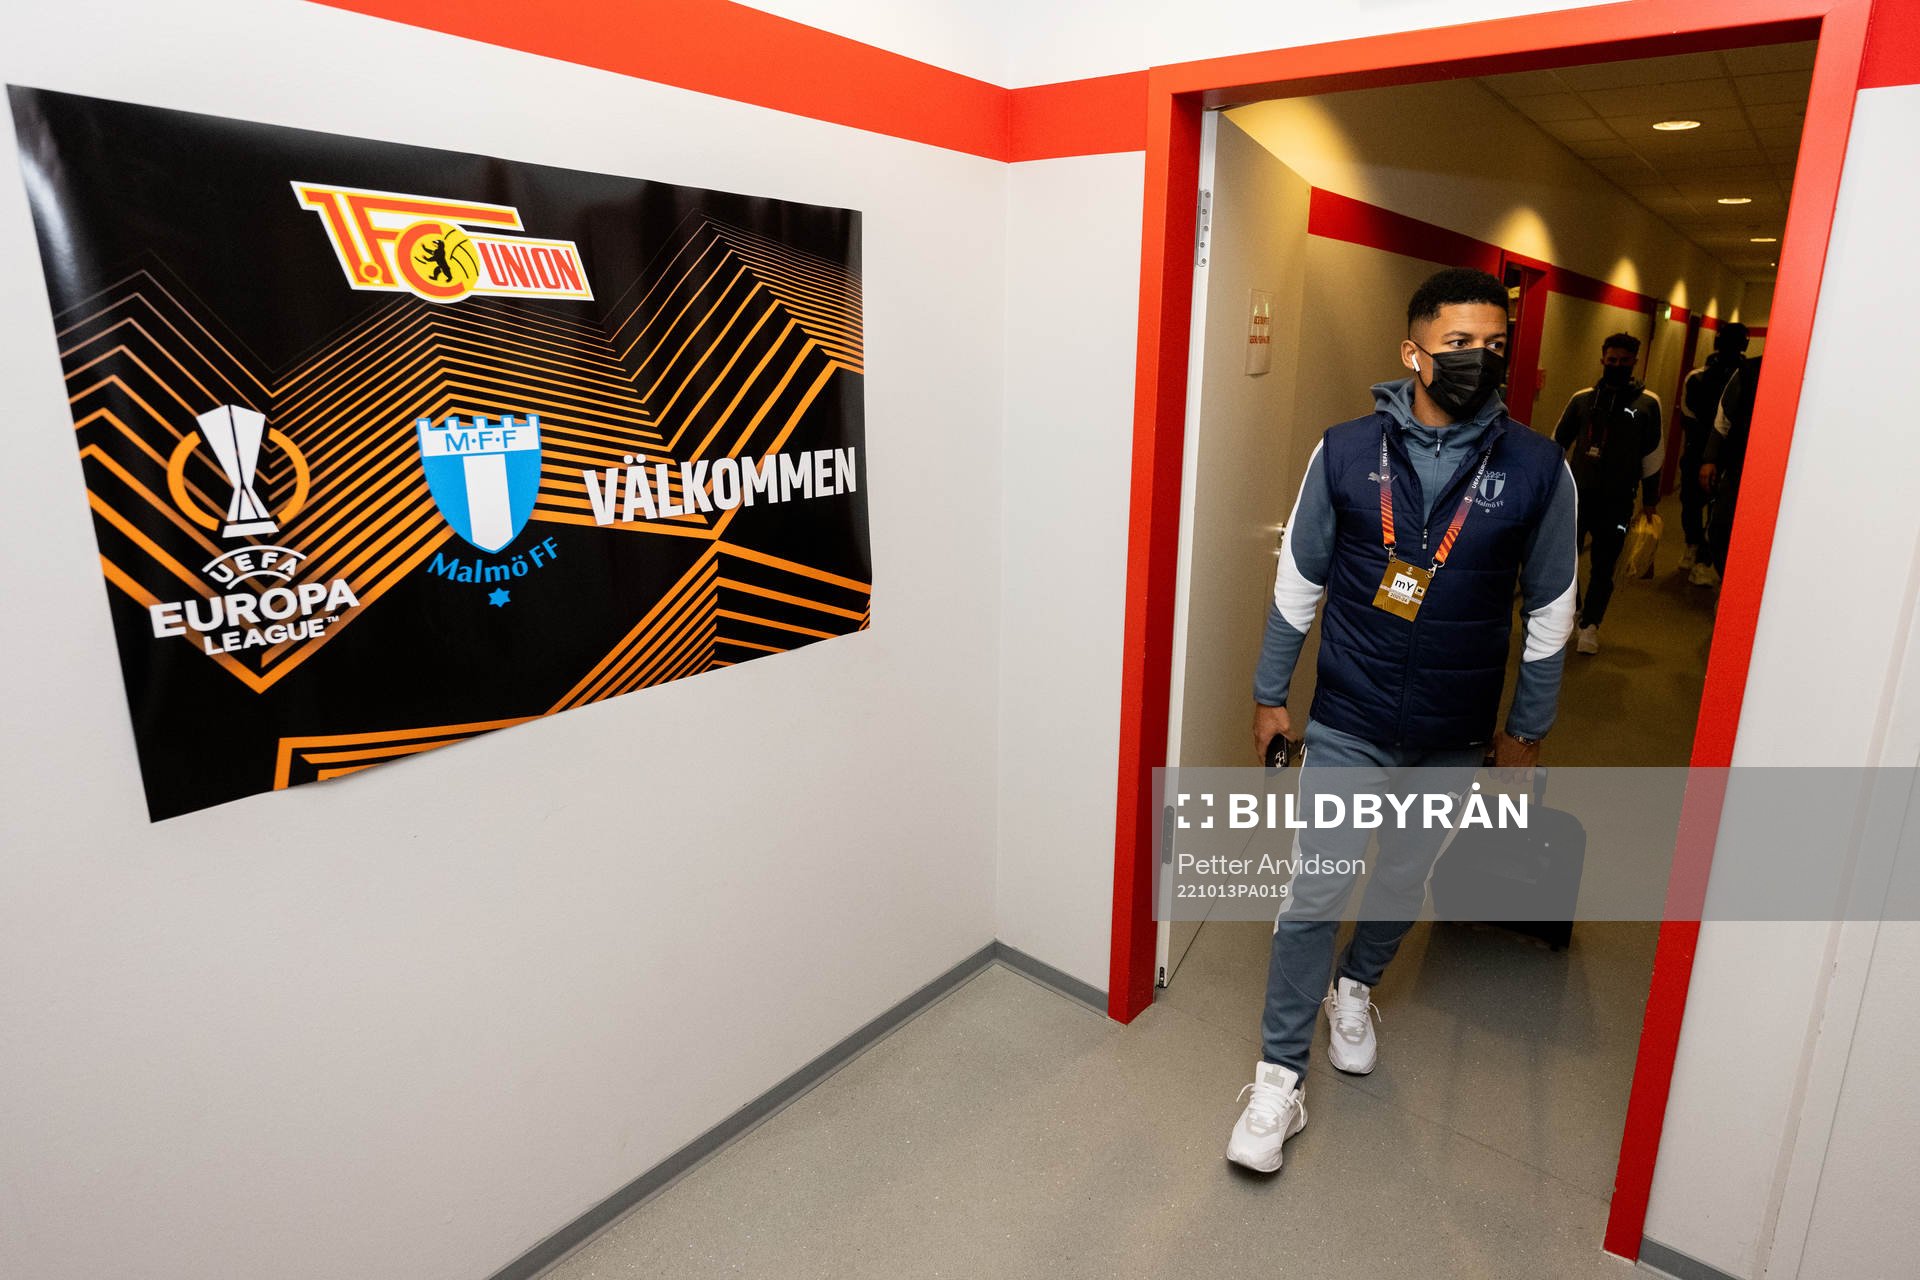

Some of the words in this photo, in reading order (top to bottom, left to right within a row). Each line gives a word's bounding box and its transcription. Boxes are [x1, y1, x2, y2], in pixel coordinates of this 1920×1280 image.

[478, 243, 583, 291] UNION
[583, 446, 857, 526] VÄLKOMMEN
[1472, 475, 1481, 489] UEFA
[208, 552, 298, 584] UEFA
[427, 552, 529, 584] Malmö
[528, 536, 561, 569] FF
[149, 578, 361, 639] EUROPA
[1394, 579, 1415, 591] mY
